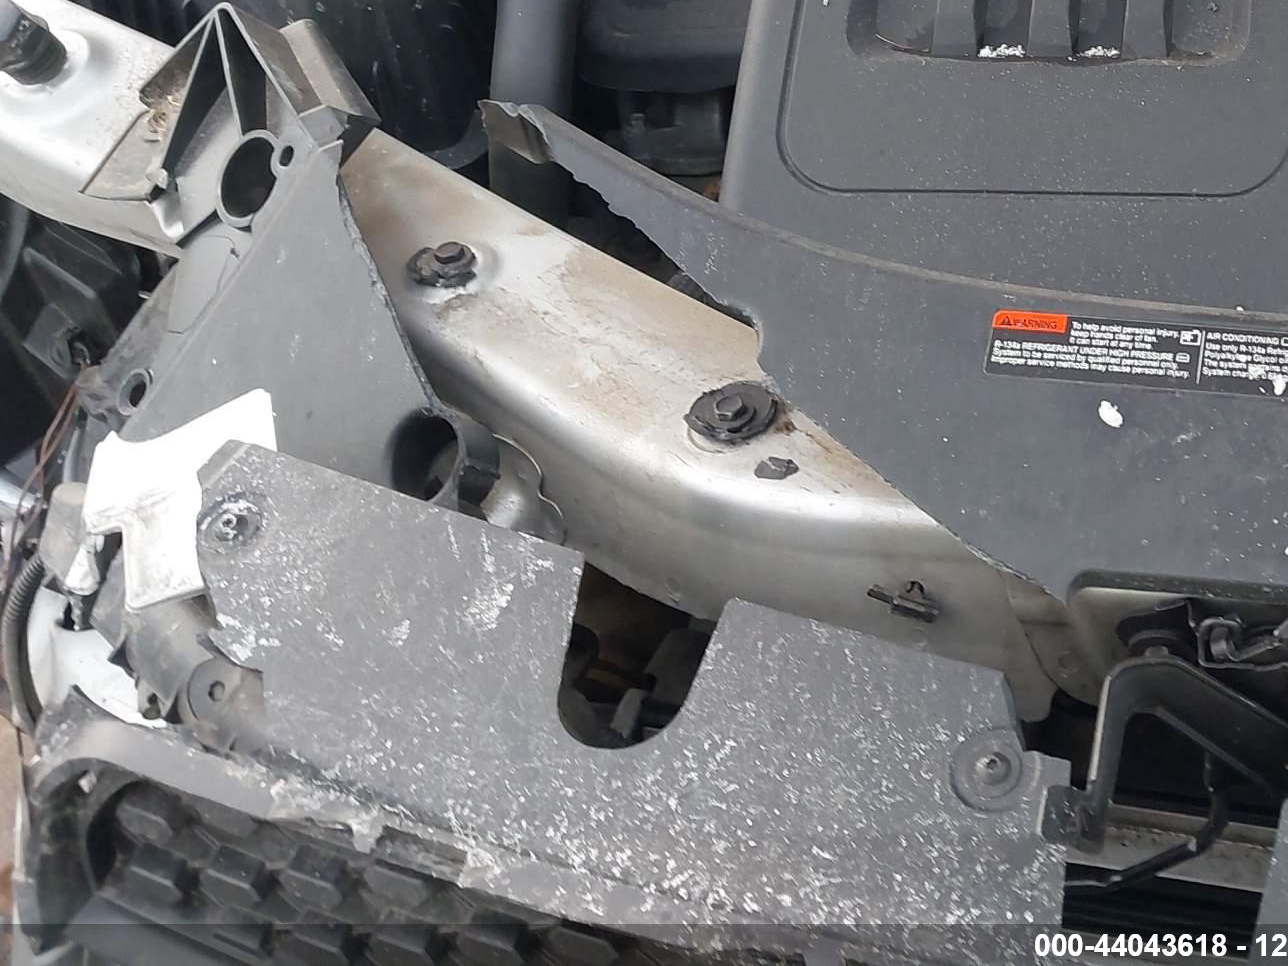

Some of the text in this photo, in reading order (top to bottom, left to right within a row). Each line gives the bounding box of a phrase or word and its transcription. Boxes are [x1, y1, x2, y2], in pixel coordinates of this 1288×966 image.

[1072, 321, 1081, 330] To
[1083, 322, 1099, 332] help
[1101, 324, 1121, 333] avoid
[1122, 327, 1155, 336] personal
[1206, 332, 1280, 345] AIR CONDITIONING
[1022, 342, 1079, 352] REFRIGERANT
[1079, 346, 1108, 355] UNDER
[1109, 349, 1130, 357] HIGH
[1130, 350, 1174, 361] PRESSURE
[1119, 342, 1133, 350] any
[1205, 342, 1220, 350] Use
[1221, 345, 1238, 354] only
[1240, 345, 1265, 354] R-134a
[992, 348, 1021, 357] System
[1043, 352, 1076, 360] serviced
[1076, 354, 1087, 363] by
[1087, 355, 1120, 365] qualified
[1253, 354, 1278, 364] Glycol
[1279, 356, 1288, 364] oil
[991, 355, 1026, 365] Improper
[1026, 359, 1055, 367] service
[1056, 361, 1090, 370] methods
[1090, 364, 1107, 373] may
[1108, 365, 1131, 373] cause
[1131, 367, 1166, 376] personal
[1203, 358, 1218, 366] The
[1219, 361, 1247, 370] system
[1202, 366, 1231, 376] System
